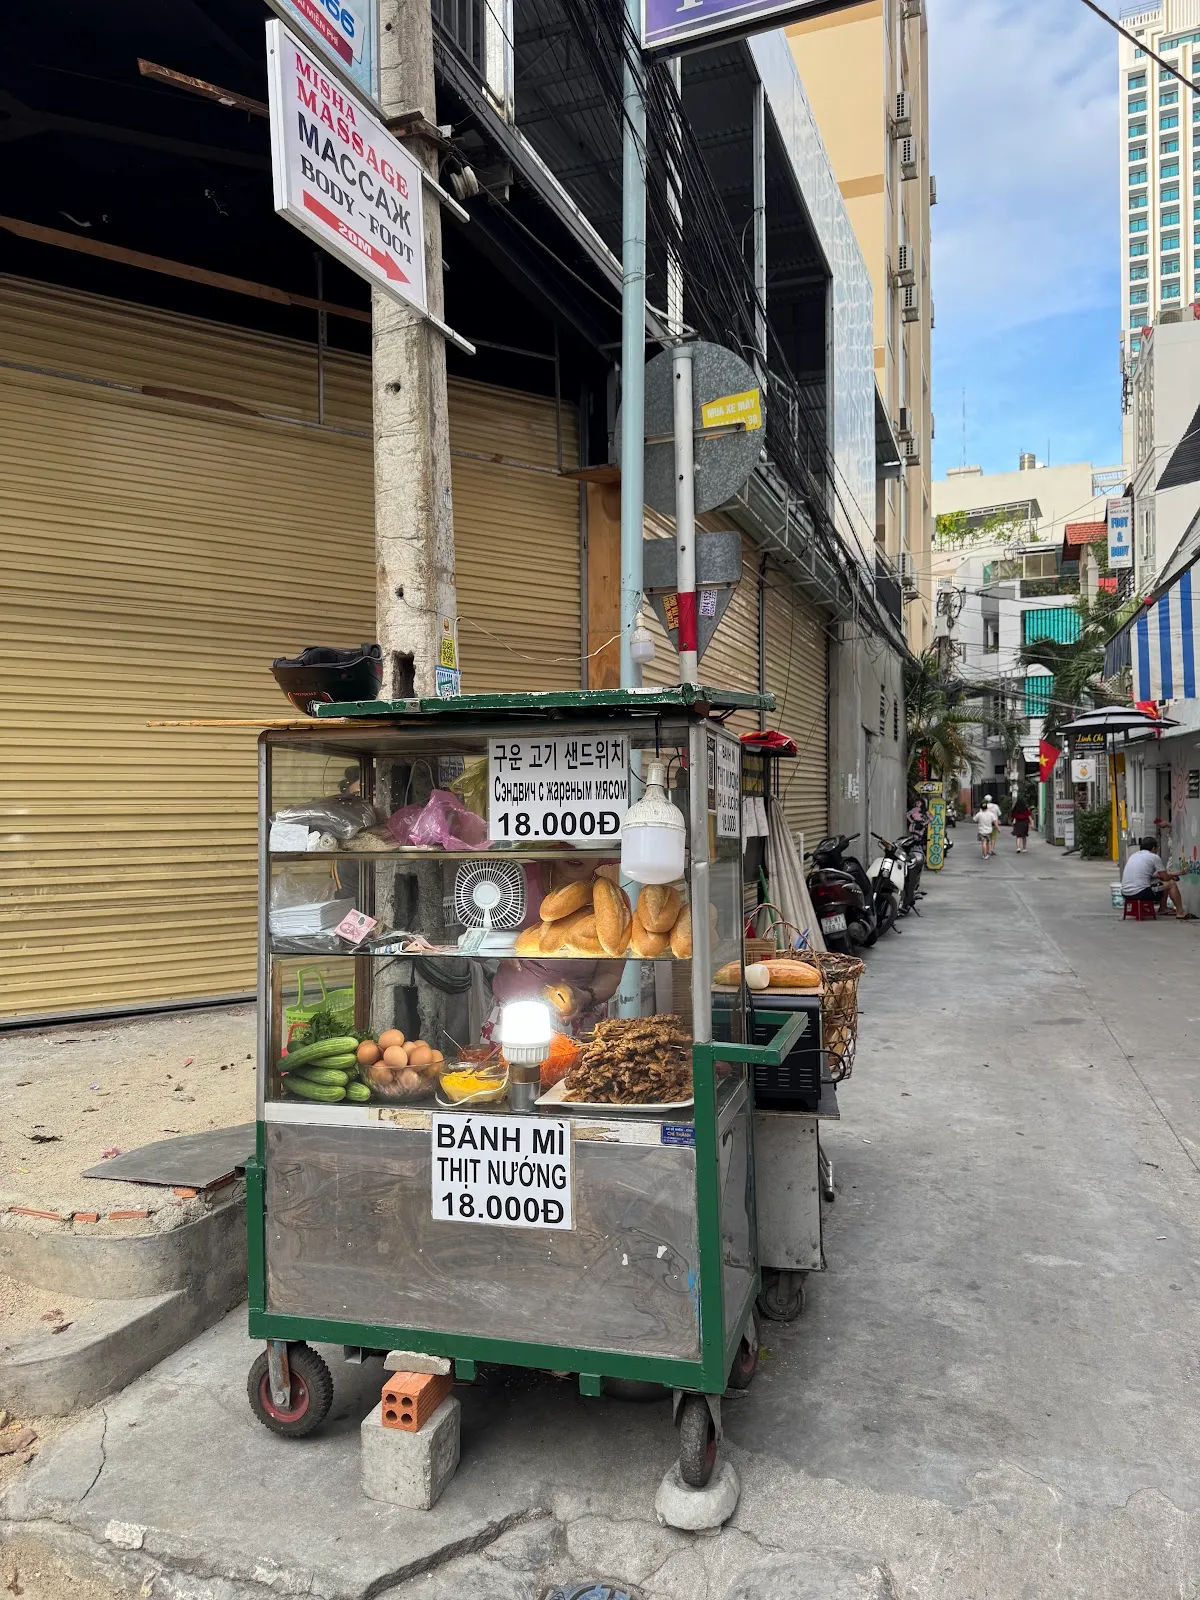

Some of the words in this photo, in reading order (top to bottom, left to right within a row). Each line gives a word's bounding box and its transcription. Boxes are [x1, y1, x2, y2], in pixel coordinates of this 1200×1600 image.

[295, 52, 358, 127] MISHA
[296, 76, 409, 200] MASSAGE
[300, 154, 354, 217] BODY
[369, 213, 414, 264] FOOT
[337, 221, 373, 257] 20M
[1111, 517, 1129, 528] FOOT
[1117, 531, 1123, 542] &
[494, 744, 522, 772] 구운
[529, 742, 556, 770] 고기
[565, 740, 625, 770] 샌드위치
[495, 776, 536, 806] Сэндвич
[539, 782, 544, 801] с
[546, 780, 592, 807] жареным
[595, 780, 627, 800] мясом
[498, 812, 620, 836] 18.000Đ
[929, 804, 944, 865] TATTOO
[438, 1118, 520, 1153] BÁNH
[533, 1122, 565, 1155] MÌ
[437, 1157, 481, 1189] THỊT
[488, 1156, 567, 1189] NƯỚNG
[442, 1193, 564, 1224] 18.000Đ
